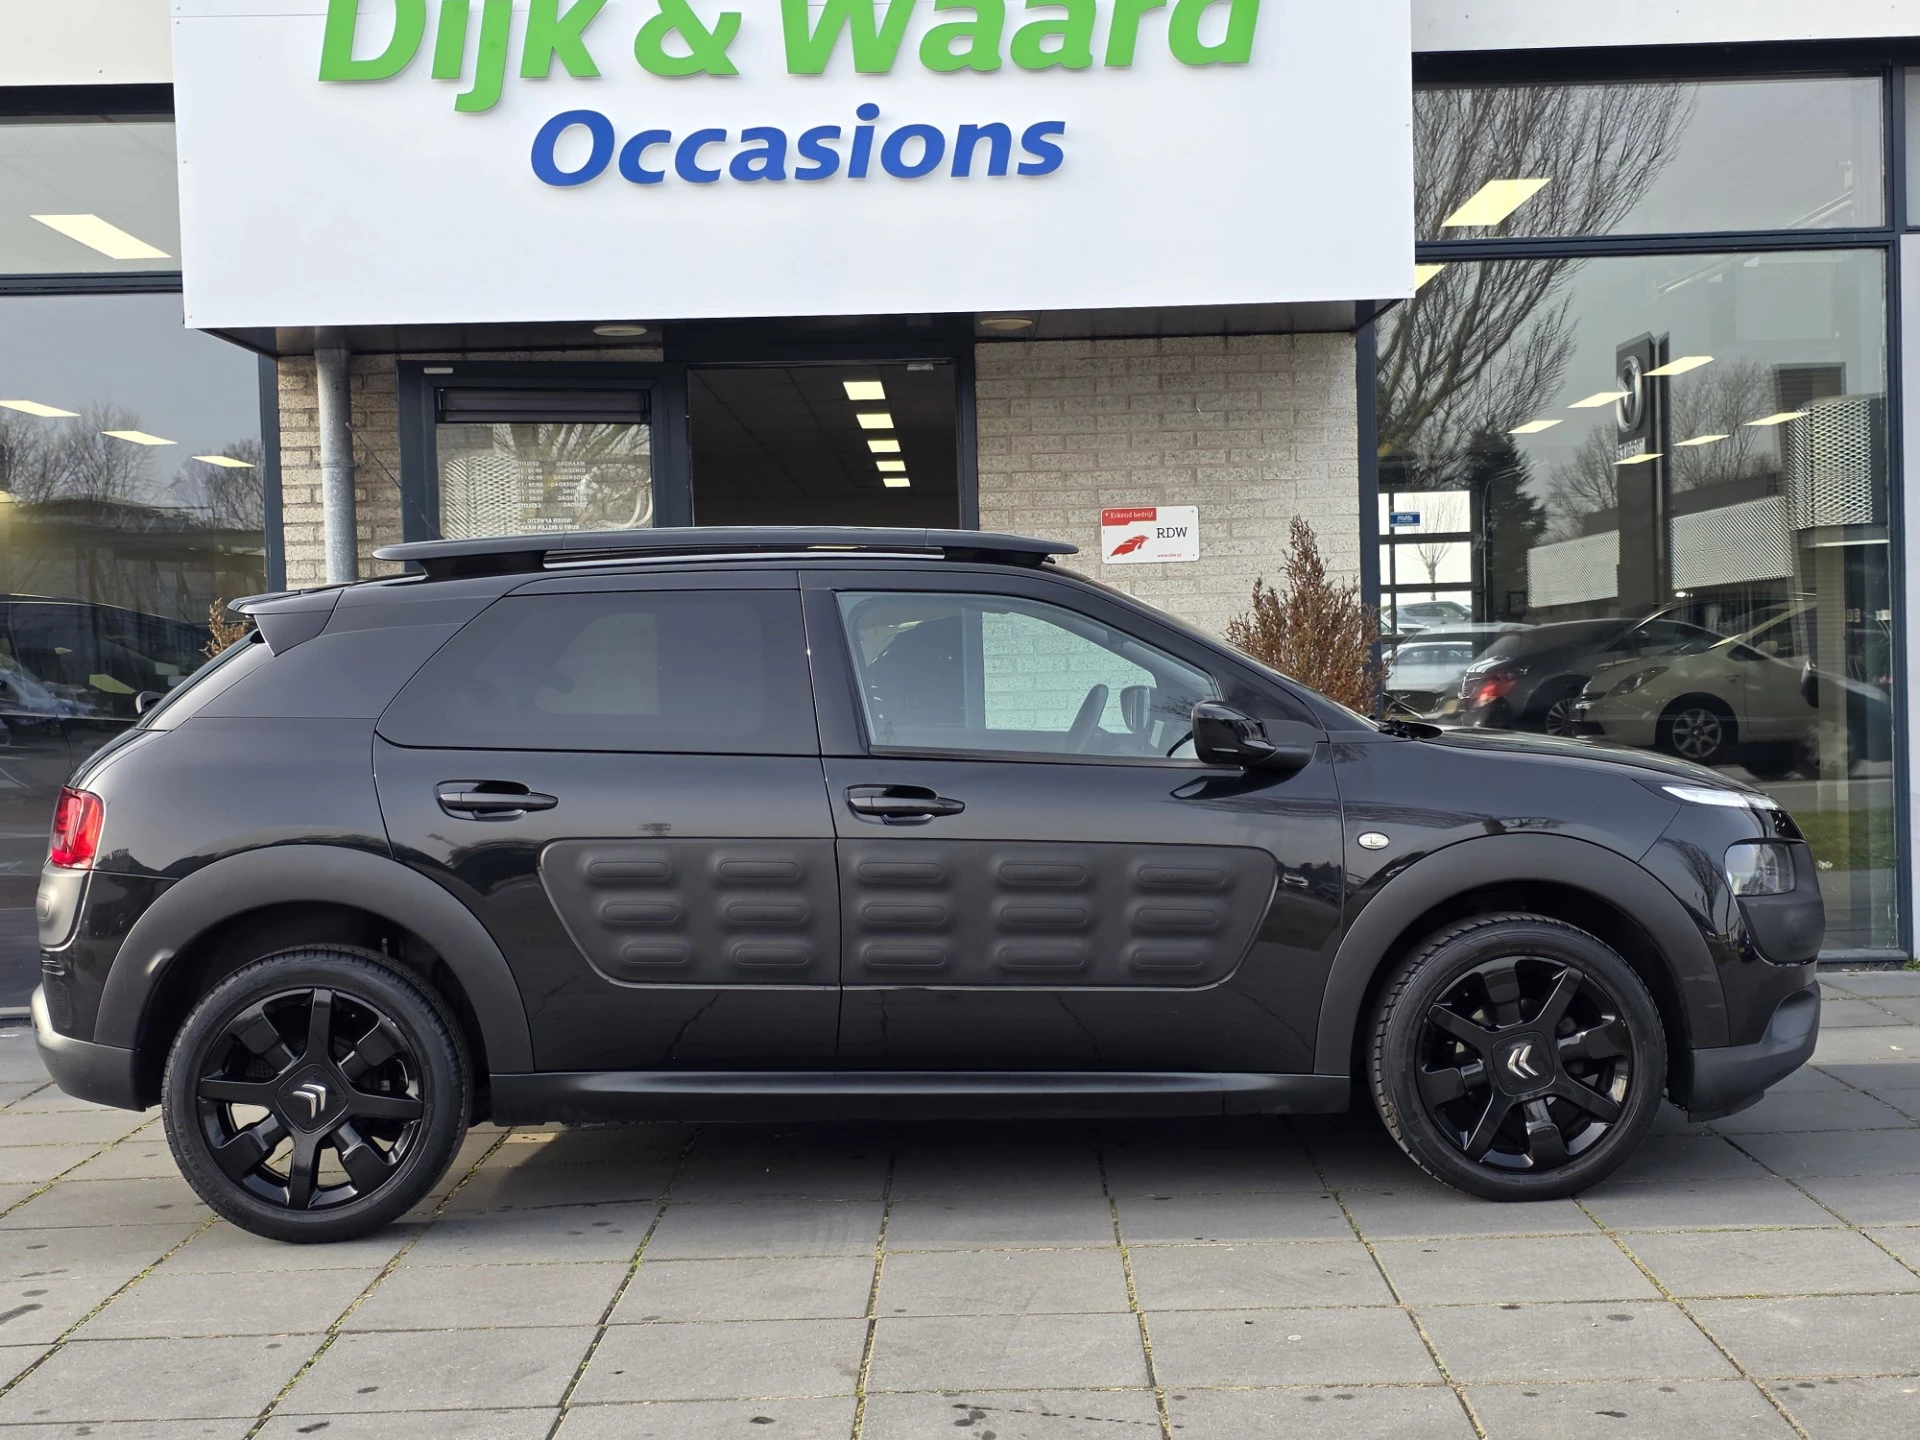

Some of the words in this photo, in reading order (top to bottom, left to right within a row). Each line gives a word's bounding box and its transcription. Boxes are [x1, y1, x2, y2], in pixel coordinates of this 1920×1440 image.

[318, 0, 606, 113] Dijk
[634, 0, 742, 77] &
[780, 0, 1260, 75] Waard
[531, 103, 1066, 187] Occasions
[1133, 511, 1154, 519] bedrijf
[1156, 527, 1188, 539] RDW
